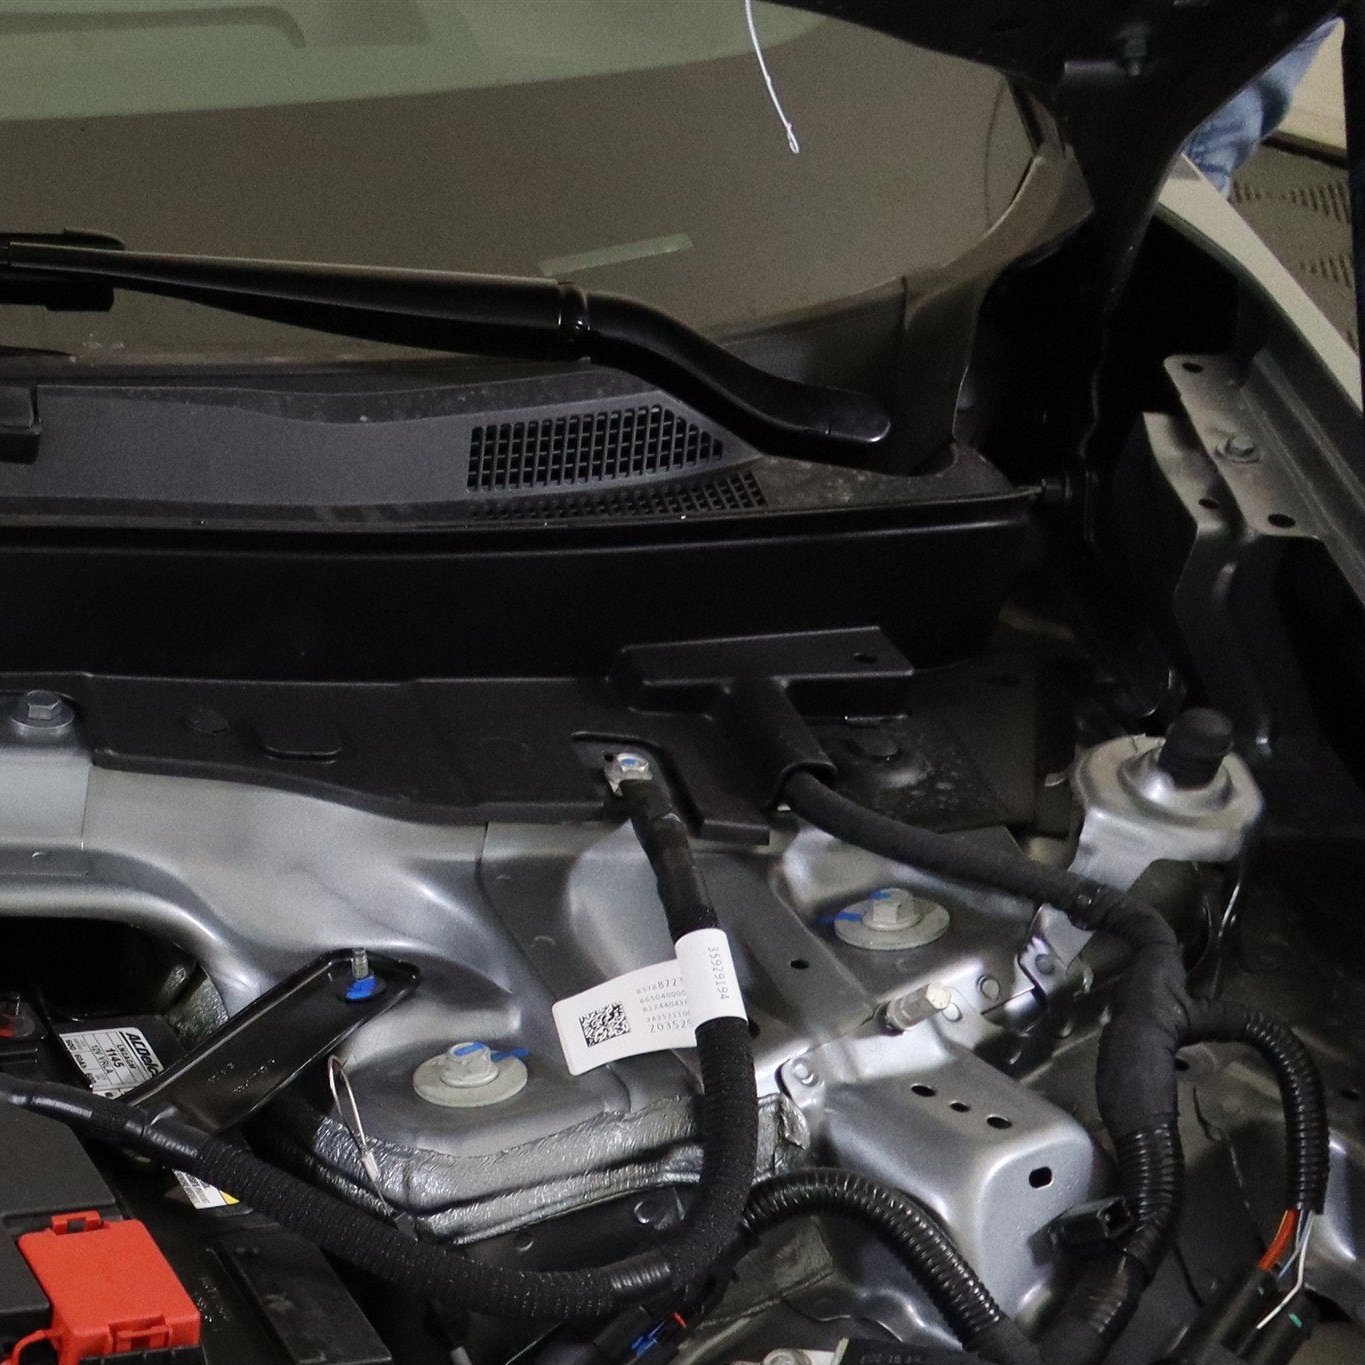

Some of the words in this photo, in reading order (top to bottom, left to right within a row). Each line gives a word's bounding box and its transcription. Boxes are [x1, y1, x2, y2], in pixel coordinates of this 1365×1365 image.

[707, 944, 729, 1000] 35929194
[90, 1043, 102, 1056] 12V
[104, 1046, 124, 1069] 1145
[95, 1056, 113, 1075] VRLA
